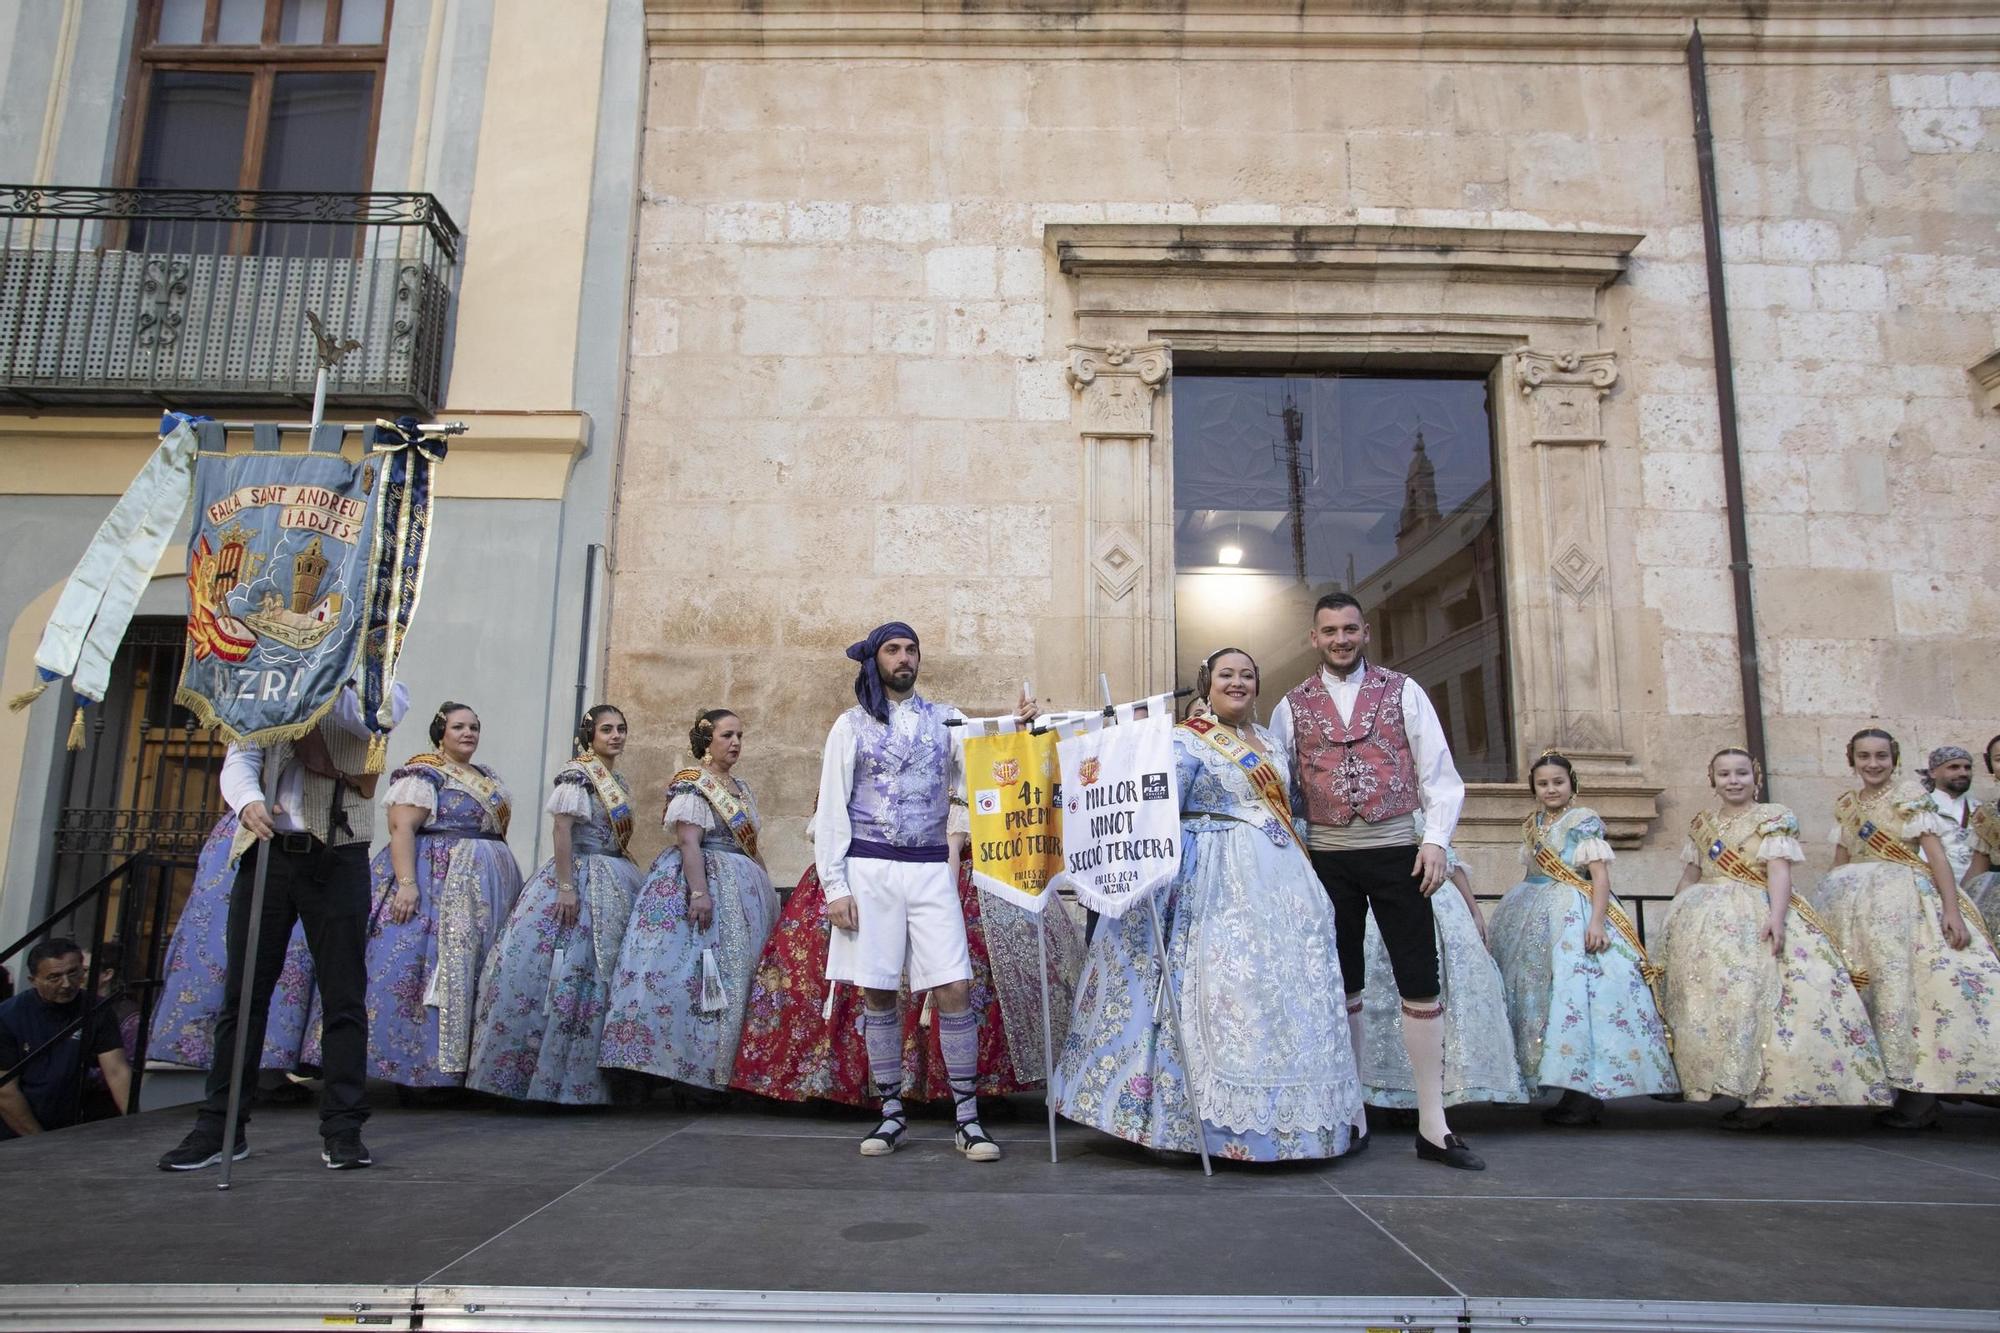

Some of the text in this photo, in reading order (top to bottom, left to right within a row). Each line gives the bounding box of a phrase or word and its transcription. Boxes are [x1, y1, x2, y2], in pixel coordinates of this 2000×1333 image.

[210, 487, 359, 522] FALLA SANT ANDREU
[296, 511, 351, 539] ADJTS
[409, 504, 426, 557] Fallera
[1230, 745, 1245, 757] 2024
[1085, 780, 1138, 811] MILLOR
[1144, 785, 1167, 793] FLEX
[1090, 810, 1135, 839] NINOT
[980, 832, 1023, 862] SECCIÓ
[1069, 837, 1174, 874] SECCIÓ TERCERA
[1094, 870, 1138, 885] FALLES 2024
[1103, 882, 1131, 895] ALZIRA
